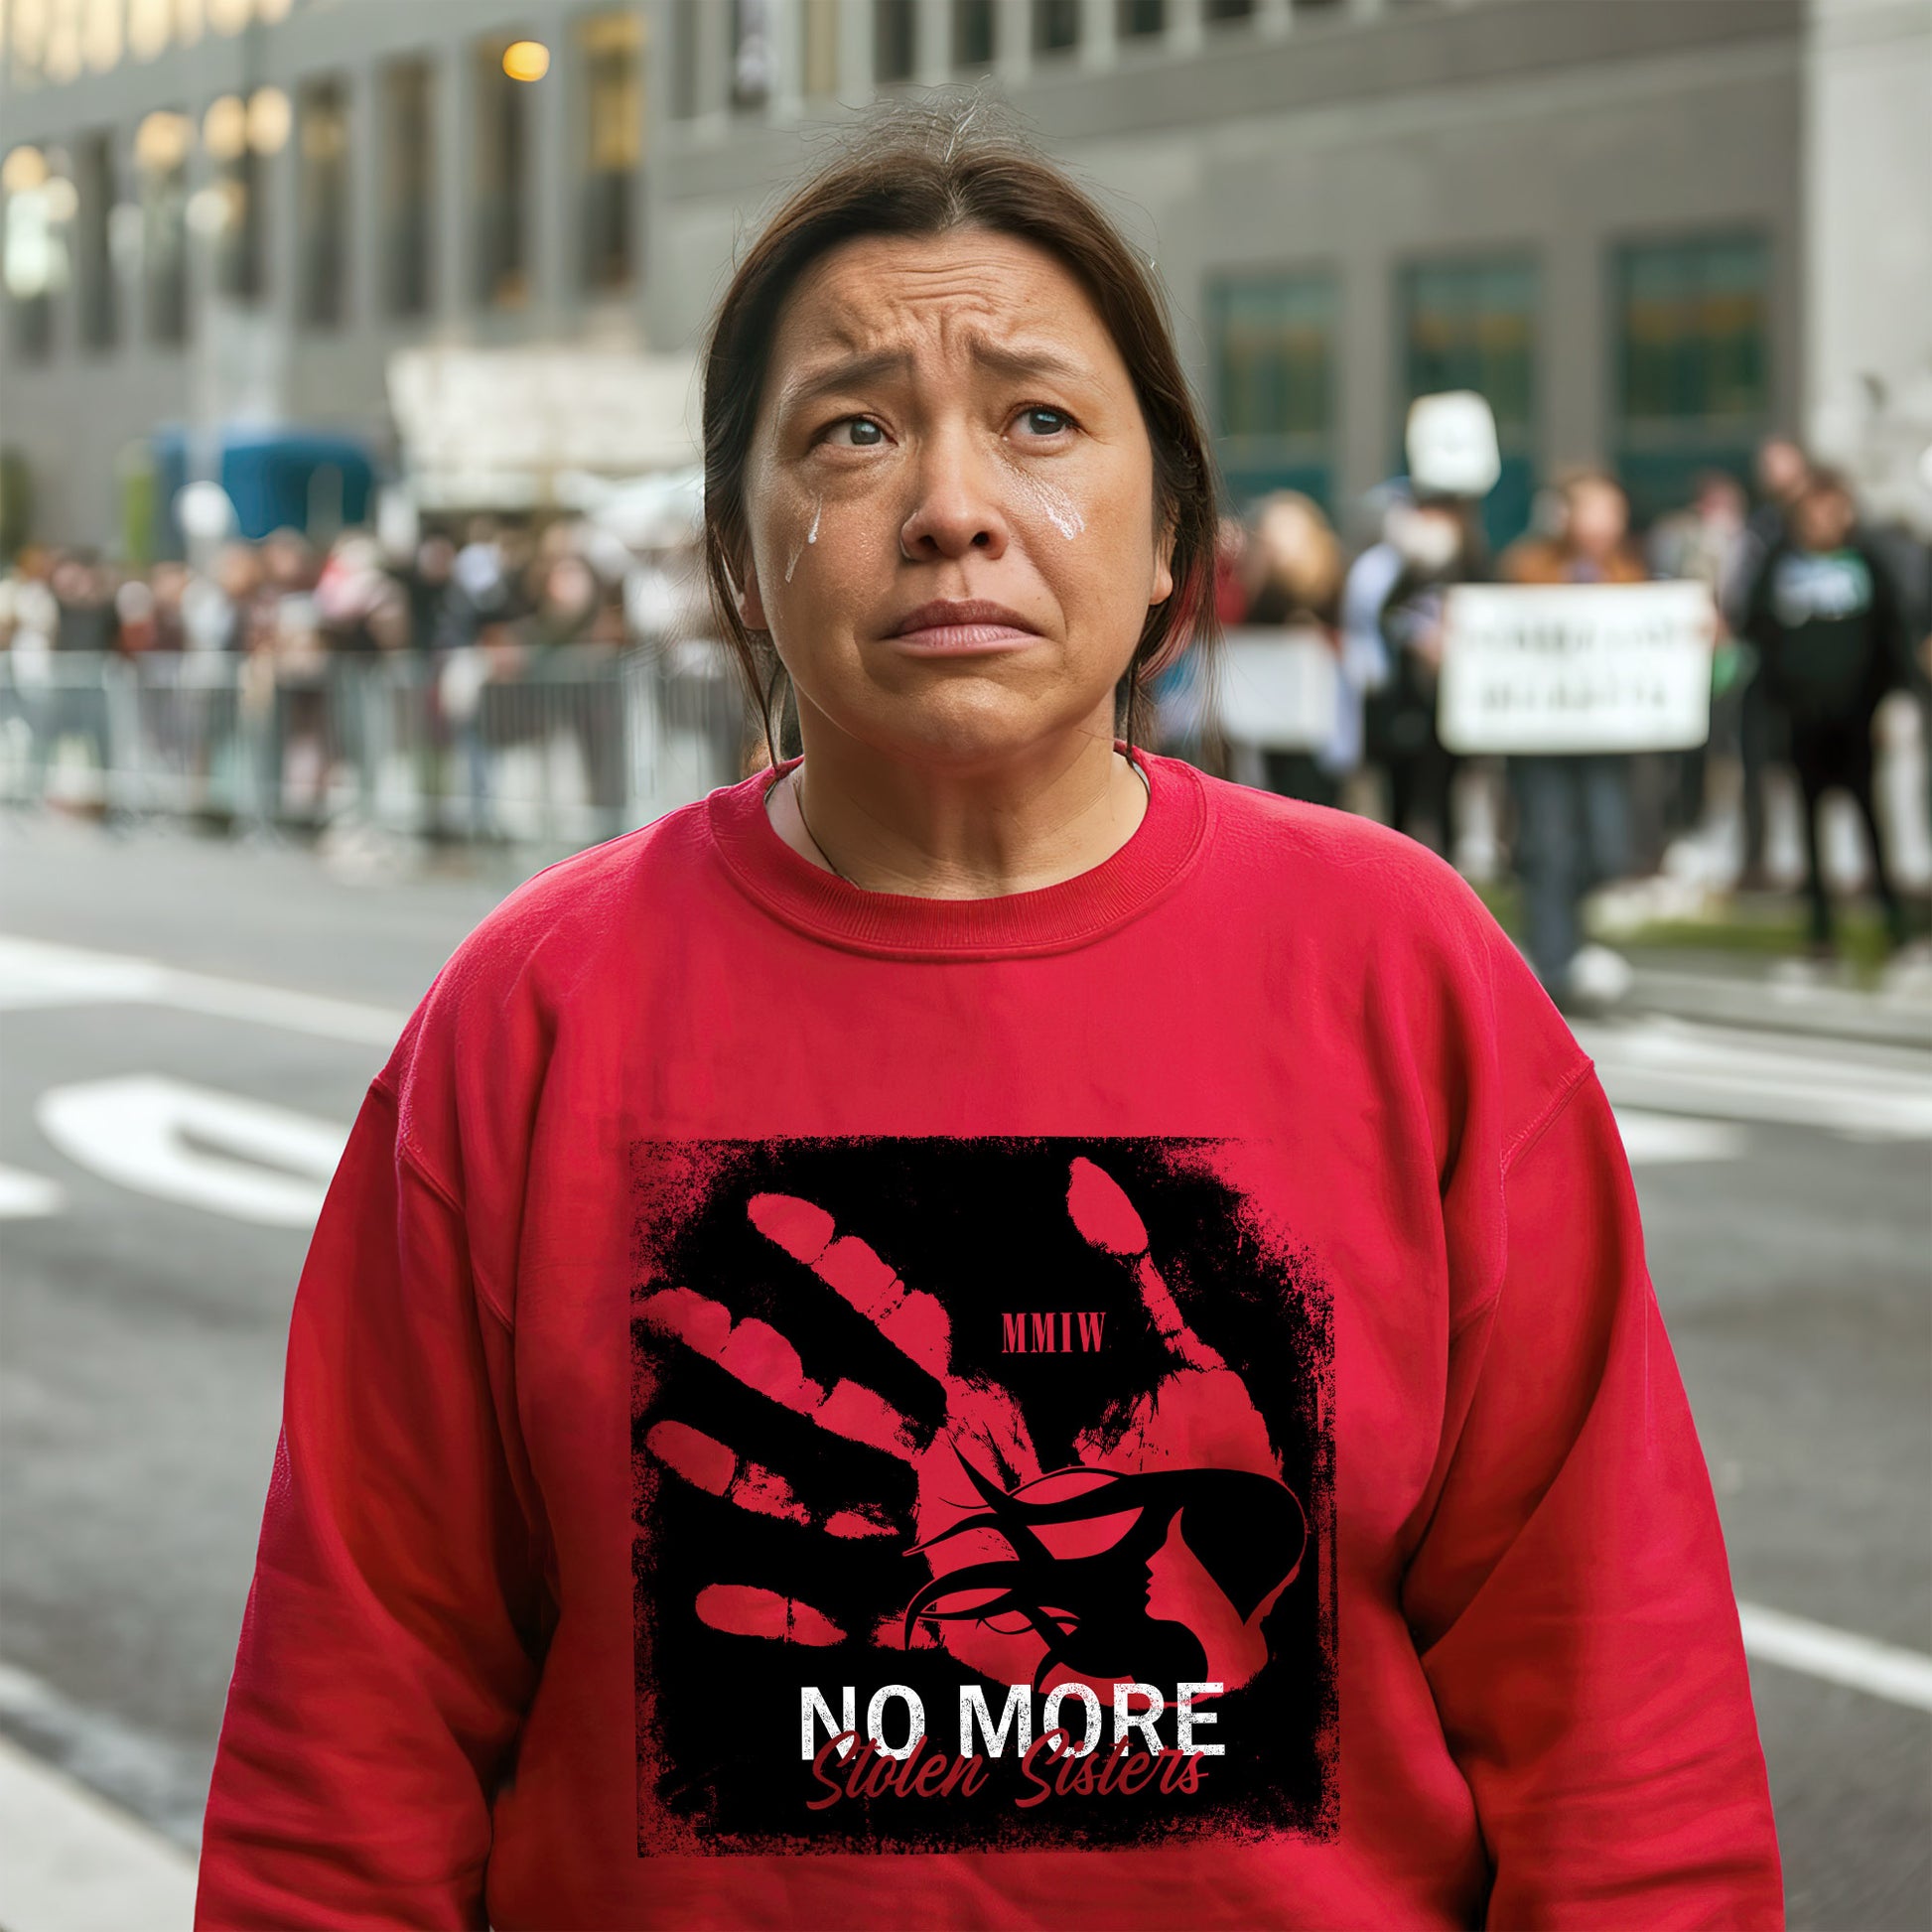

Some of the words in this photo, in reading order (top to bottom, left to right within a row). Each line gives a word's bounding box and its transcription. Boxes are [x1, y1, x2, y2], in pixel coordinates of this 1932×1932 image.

[1001, 1311, 1107, 1353] MMIW
[800, 1685, 925, 1760] NO
[959, 1682, 1226, 1758] MORE
[805, 1729, 990, 1810] Stolen
[1015, 1727, 1209, 1808] Sisters
